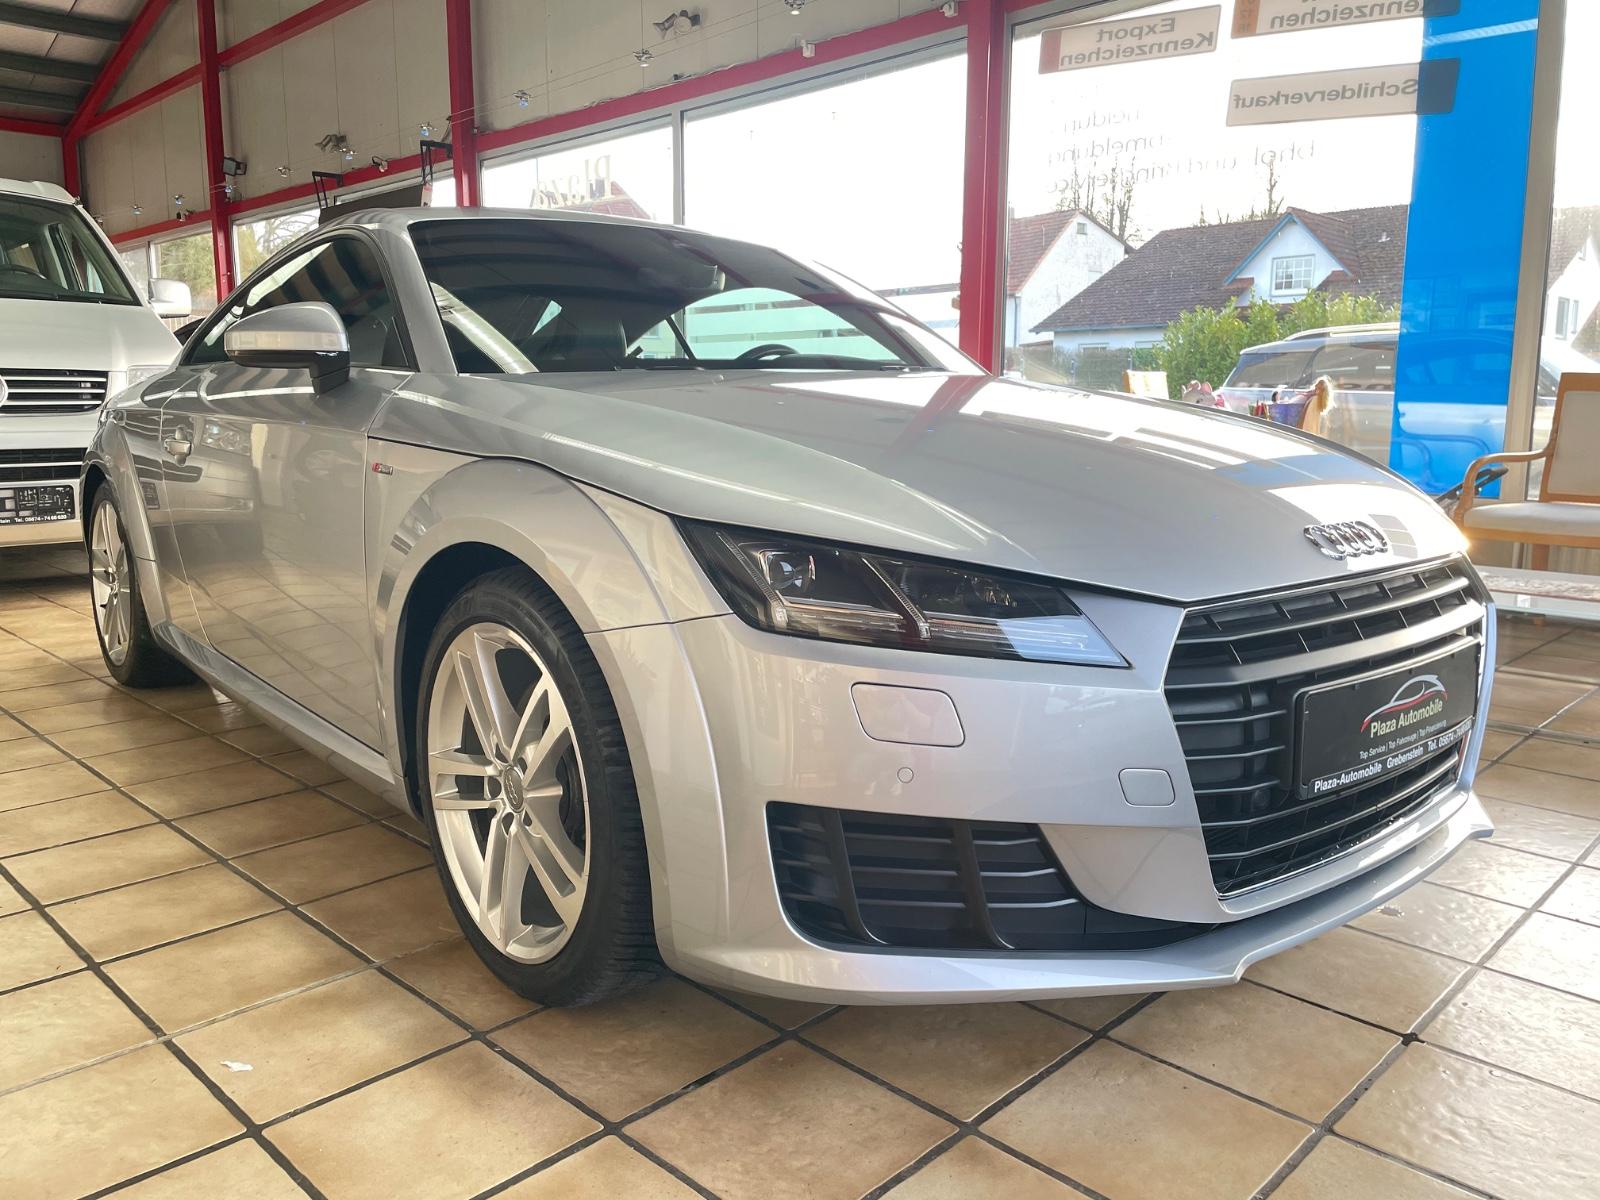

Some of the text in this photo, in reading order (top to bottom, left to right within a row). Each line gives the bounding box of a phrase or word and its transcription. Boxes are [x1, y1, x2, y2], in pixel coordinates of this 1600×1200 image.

[1370, 698, 1444, 738] Plaza Automobile
[1315, 766, 1382, 792] Plaza-Automobile
[1387, 746, 1424, 769] Grebenstein
[1428, 738, 1438, 751] Tel.
[1359, 750, 1368, 759] Top
[1369, 745, 1386, 757] Service
[1388, 740, 1397, 751] Top
